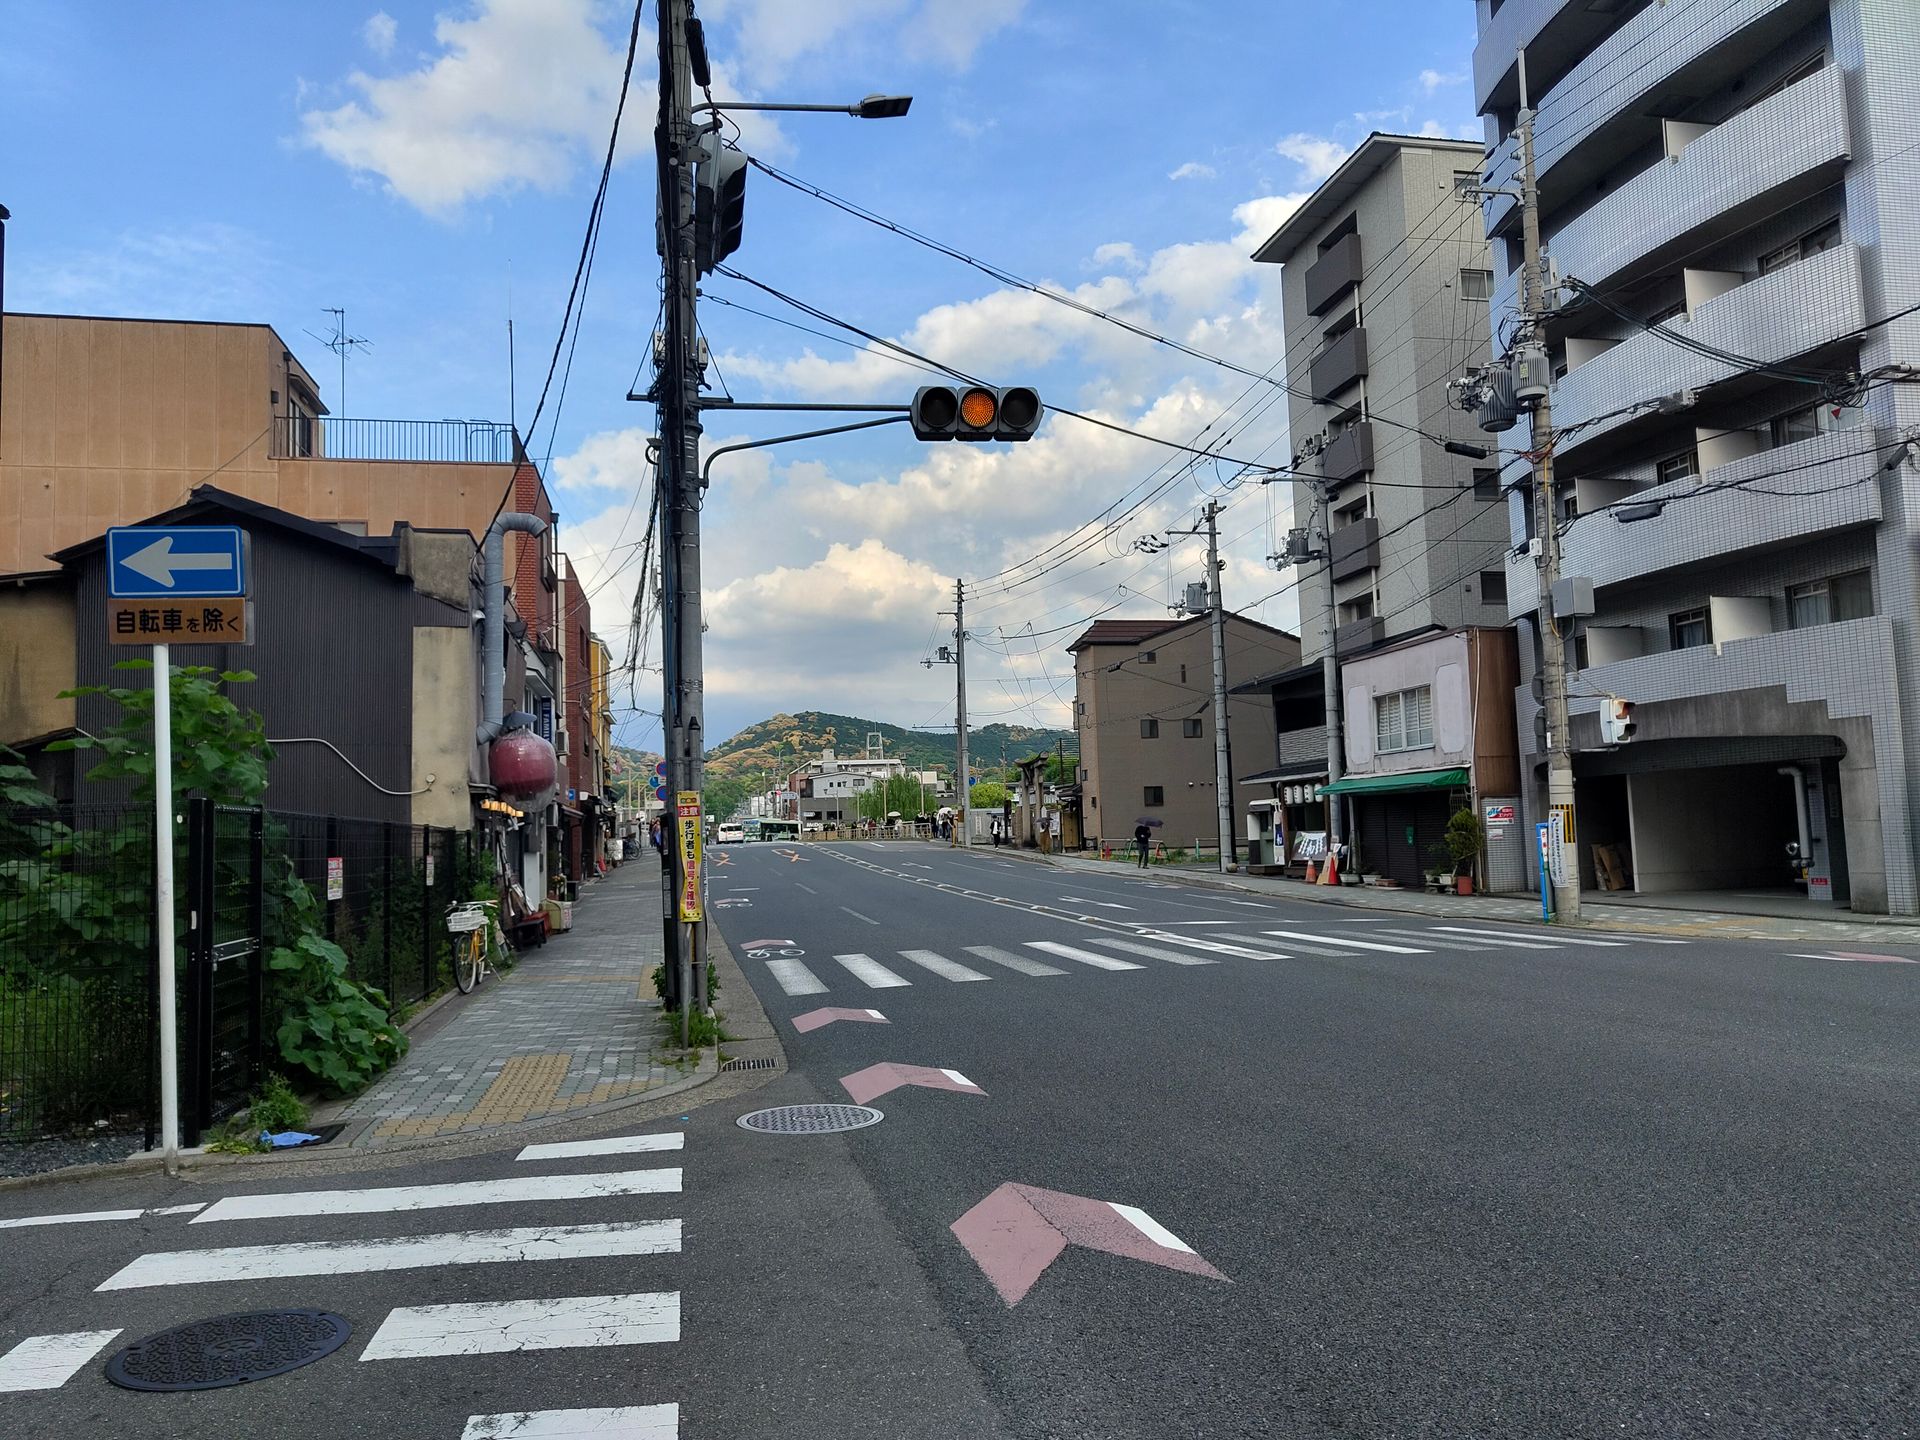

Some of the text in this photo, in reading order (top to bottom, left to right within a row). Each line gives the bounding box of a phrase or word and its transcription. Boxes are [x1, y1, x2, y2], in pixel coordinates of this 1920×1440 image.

[116, 608, 238, 634] 自転車を除く
[680, 807, 698, 816] 注意
[684, 820, 696, 910] 歩行者も信号を確認
